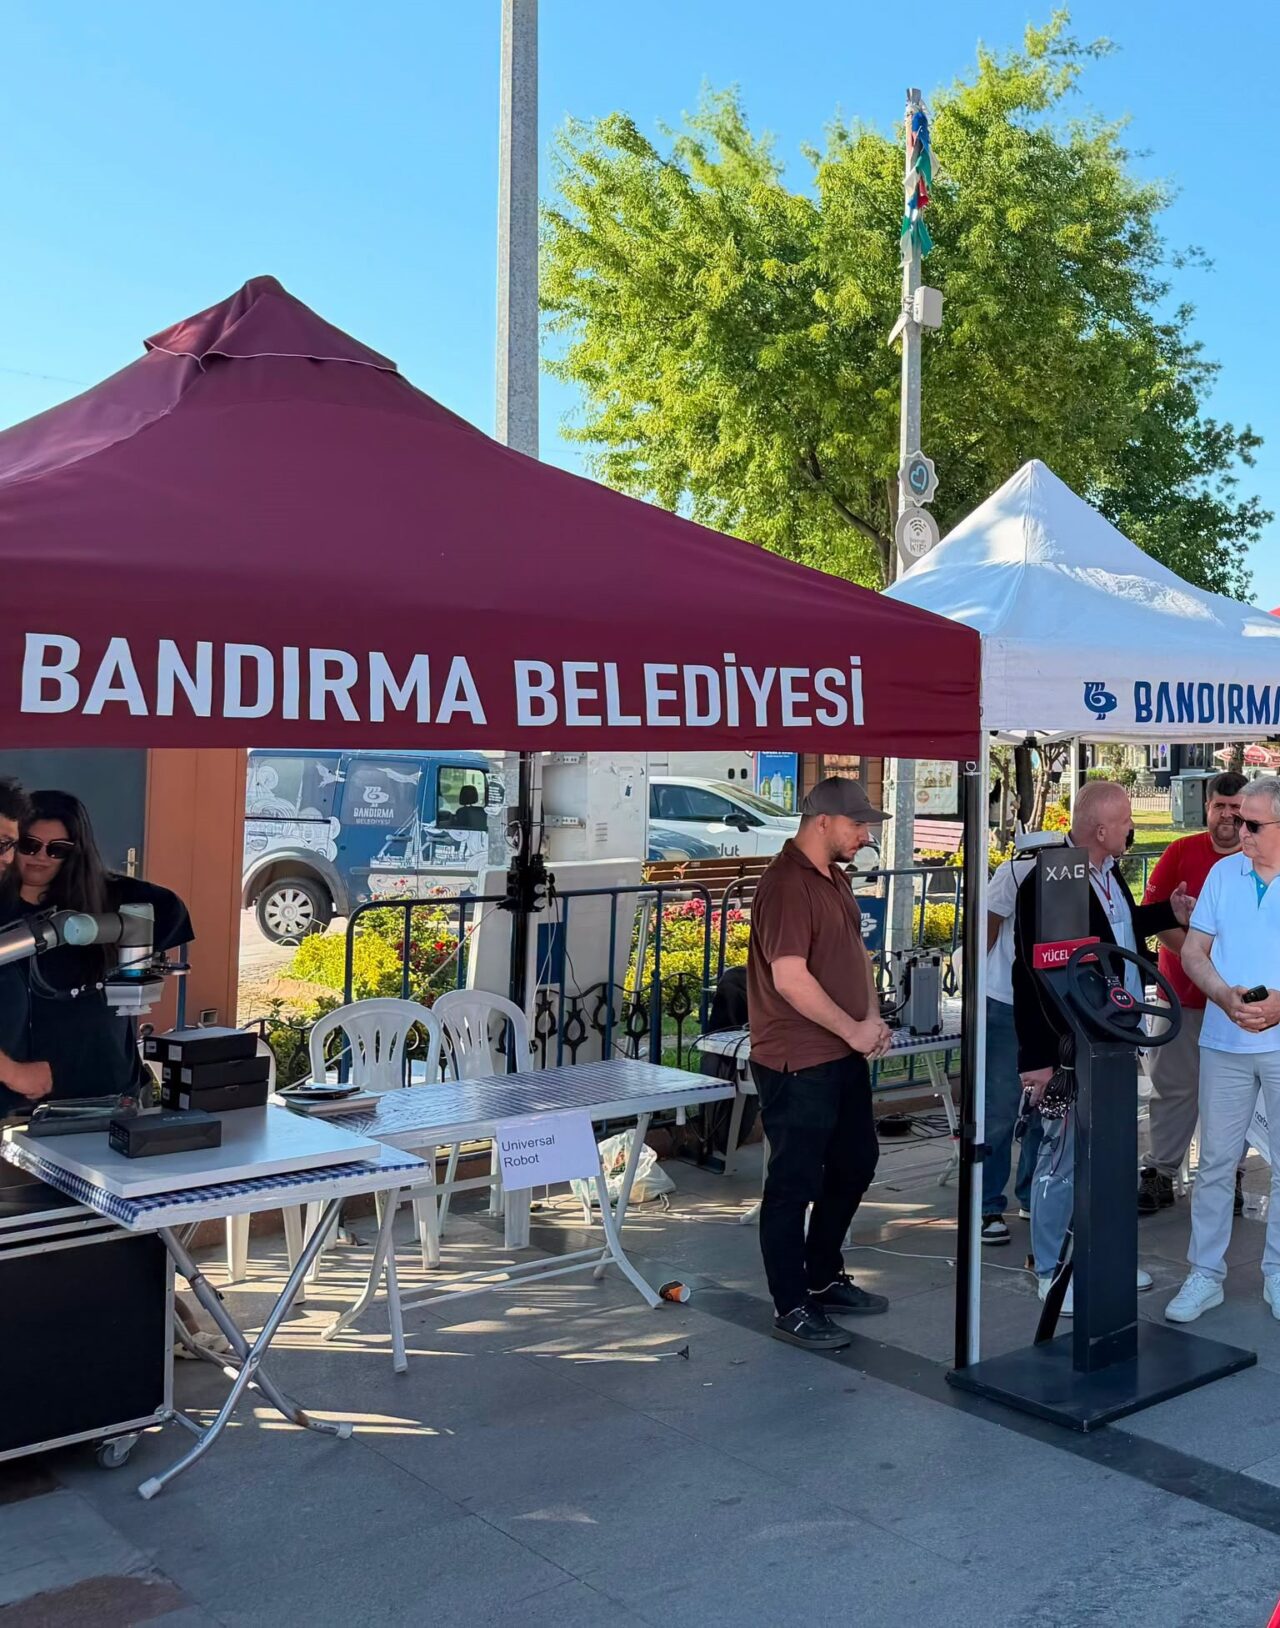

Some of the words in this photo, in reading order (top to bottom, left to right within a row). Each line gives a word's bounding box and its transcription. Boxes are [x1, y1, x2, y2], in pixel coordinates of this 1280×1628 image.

[20, 632, 488, 725] BANDIRMA
[513, 652, 865, 727] BELEDİYESİ
[353, 808, 395, 819] BANDIRMA
[1045, 863, 1086, 882] XAG
[1041, 949, 1070, 963] YÜCEL
[501, 1134, 556, 1151] Universal
[504, 1154, 540, 1168] Robot
